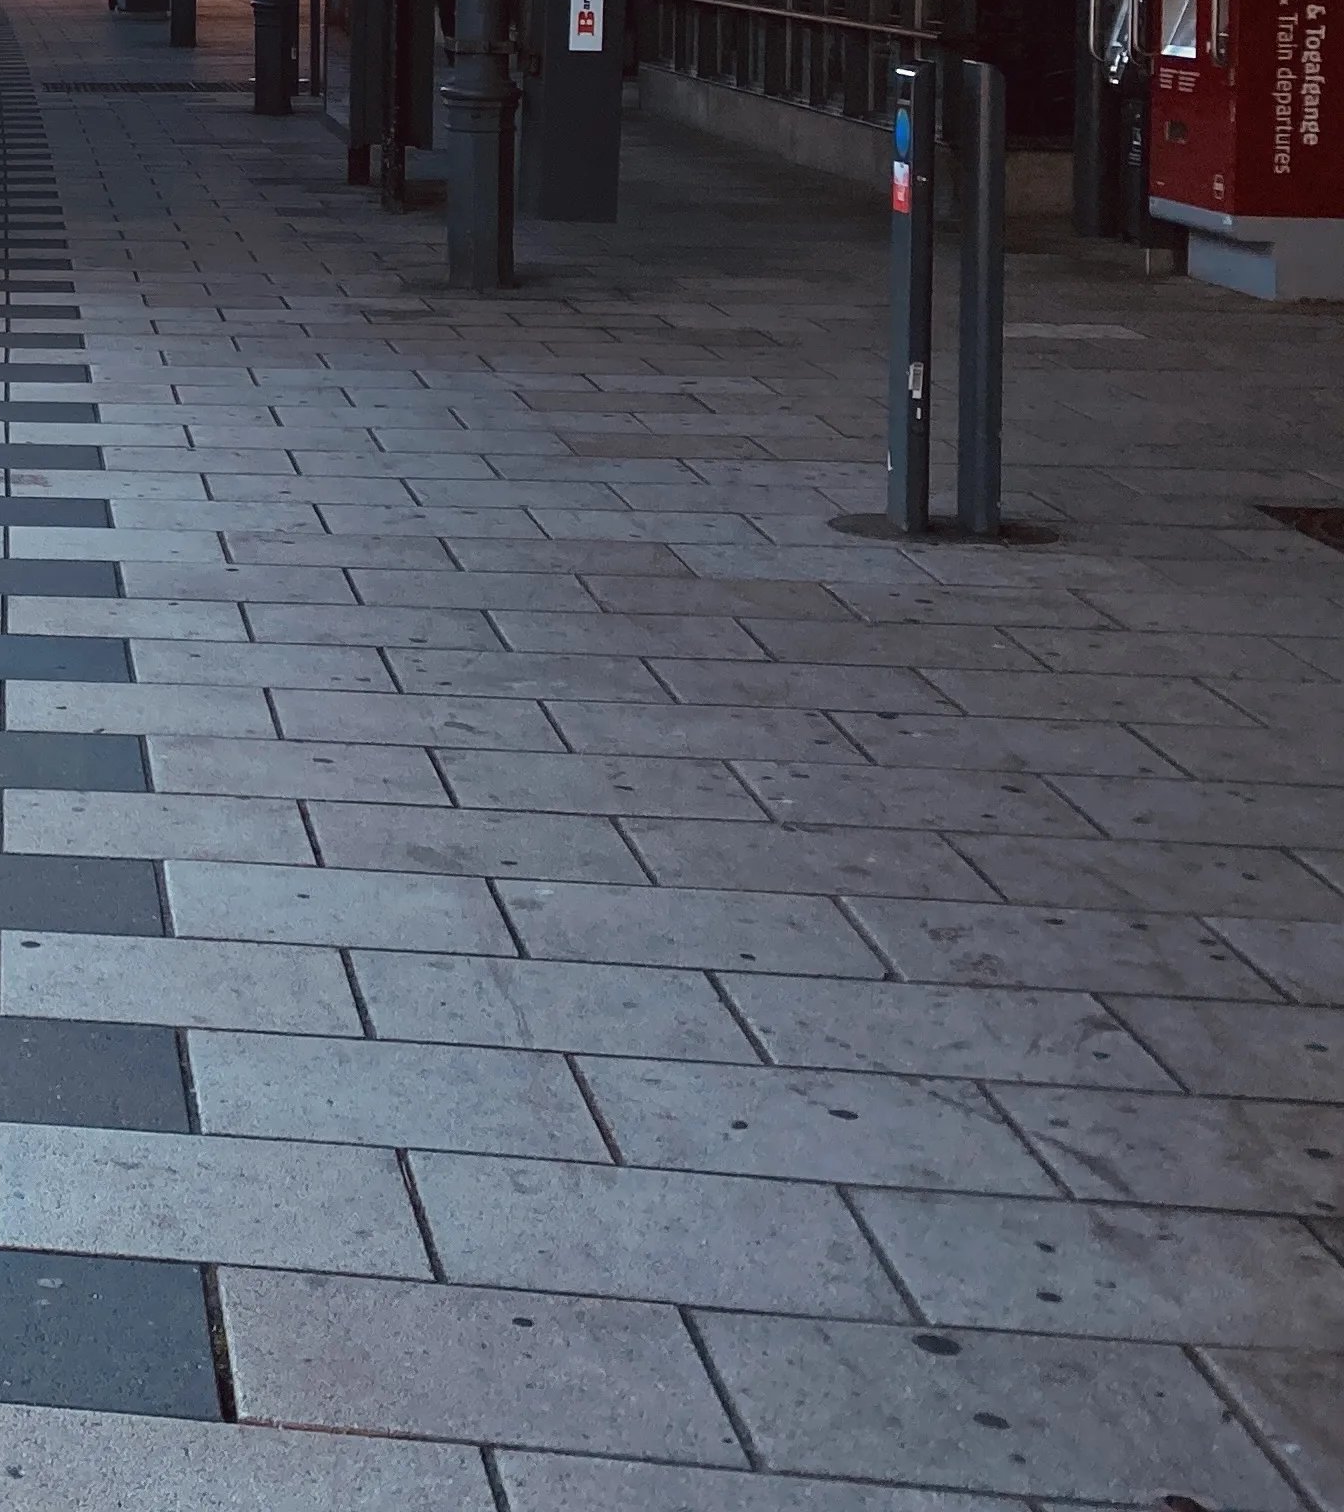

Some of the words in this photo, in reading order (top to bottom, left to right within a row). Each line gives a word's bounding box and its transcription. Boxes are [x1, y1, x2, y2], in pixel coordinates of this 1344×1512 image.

[1276, 12, 1299, 60] Train
[1306, 4, 1327, 20] &
[1271, 67, 1299, 174] departures
[1300, 25, 1326, 146] Togafgange
